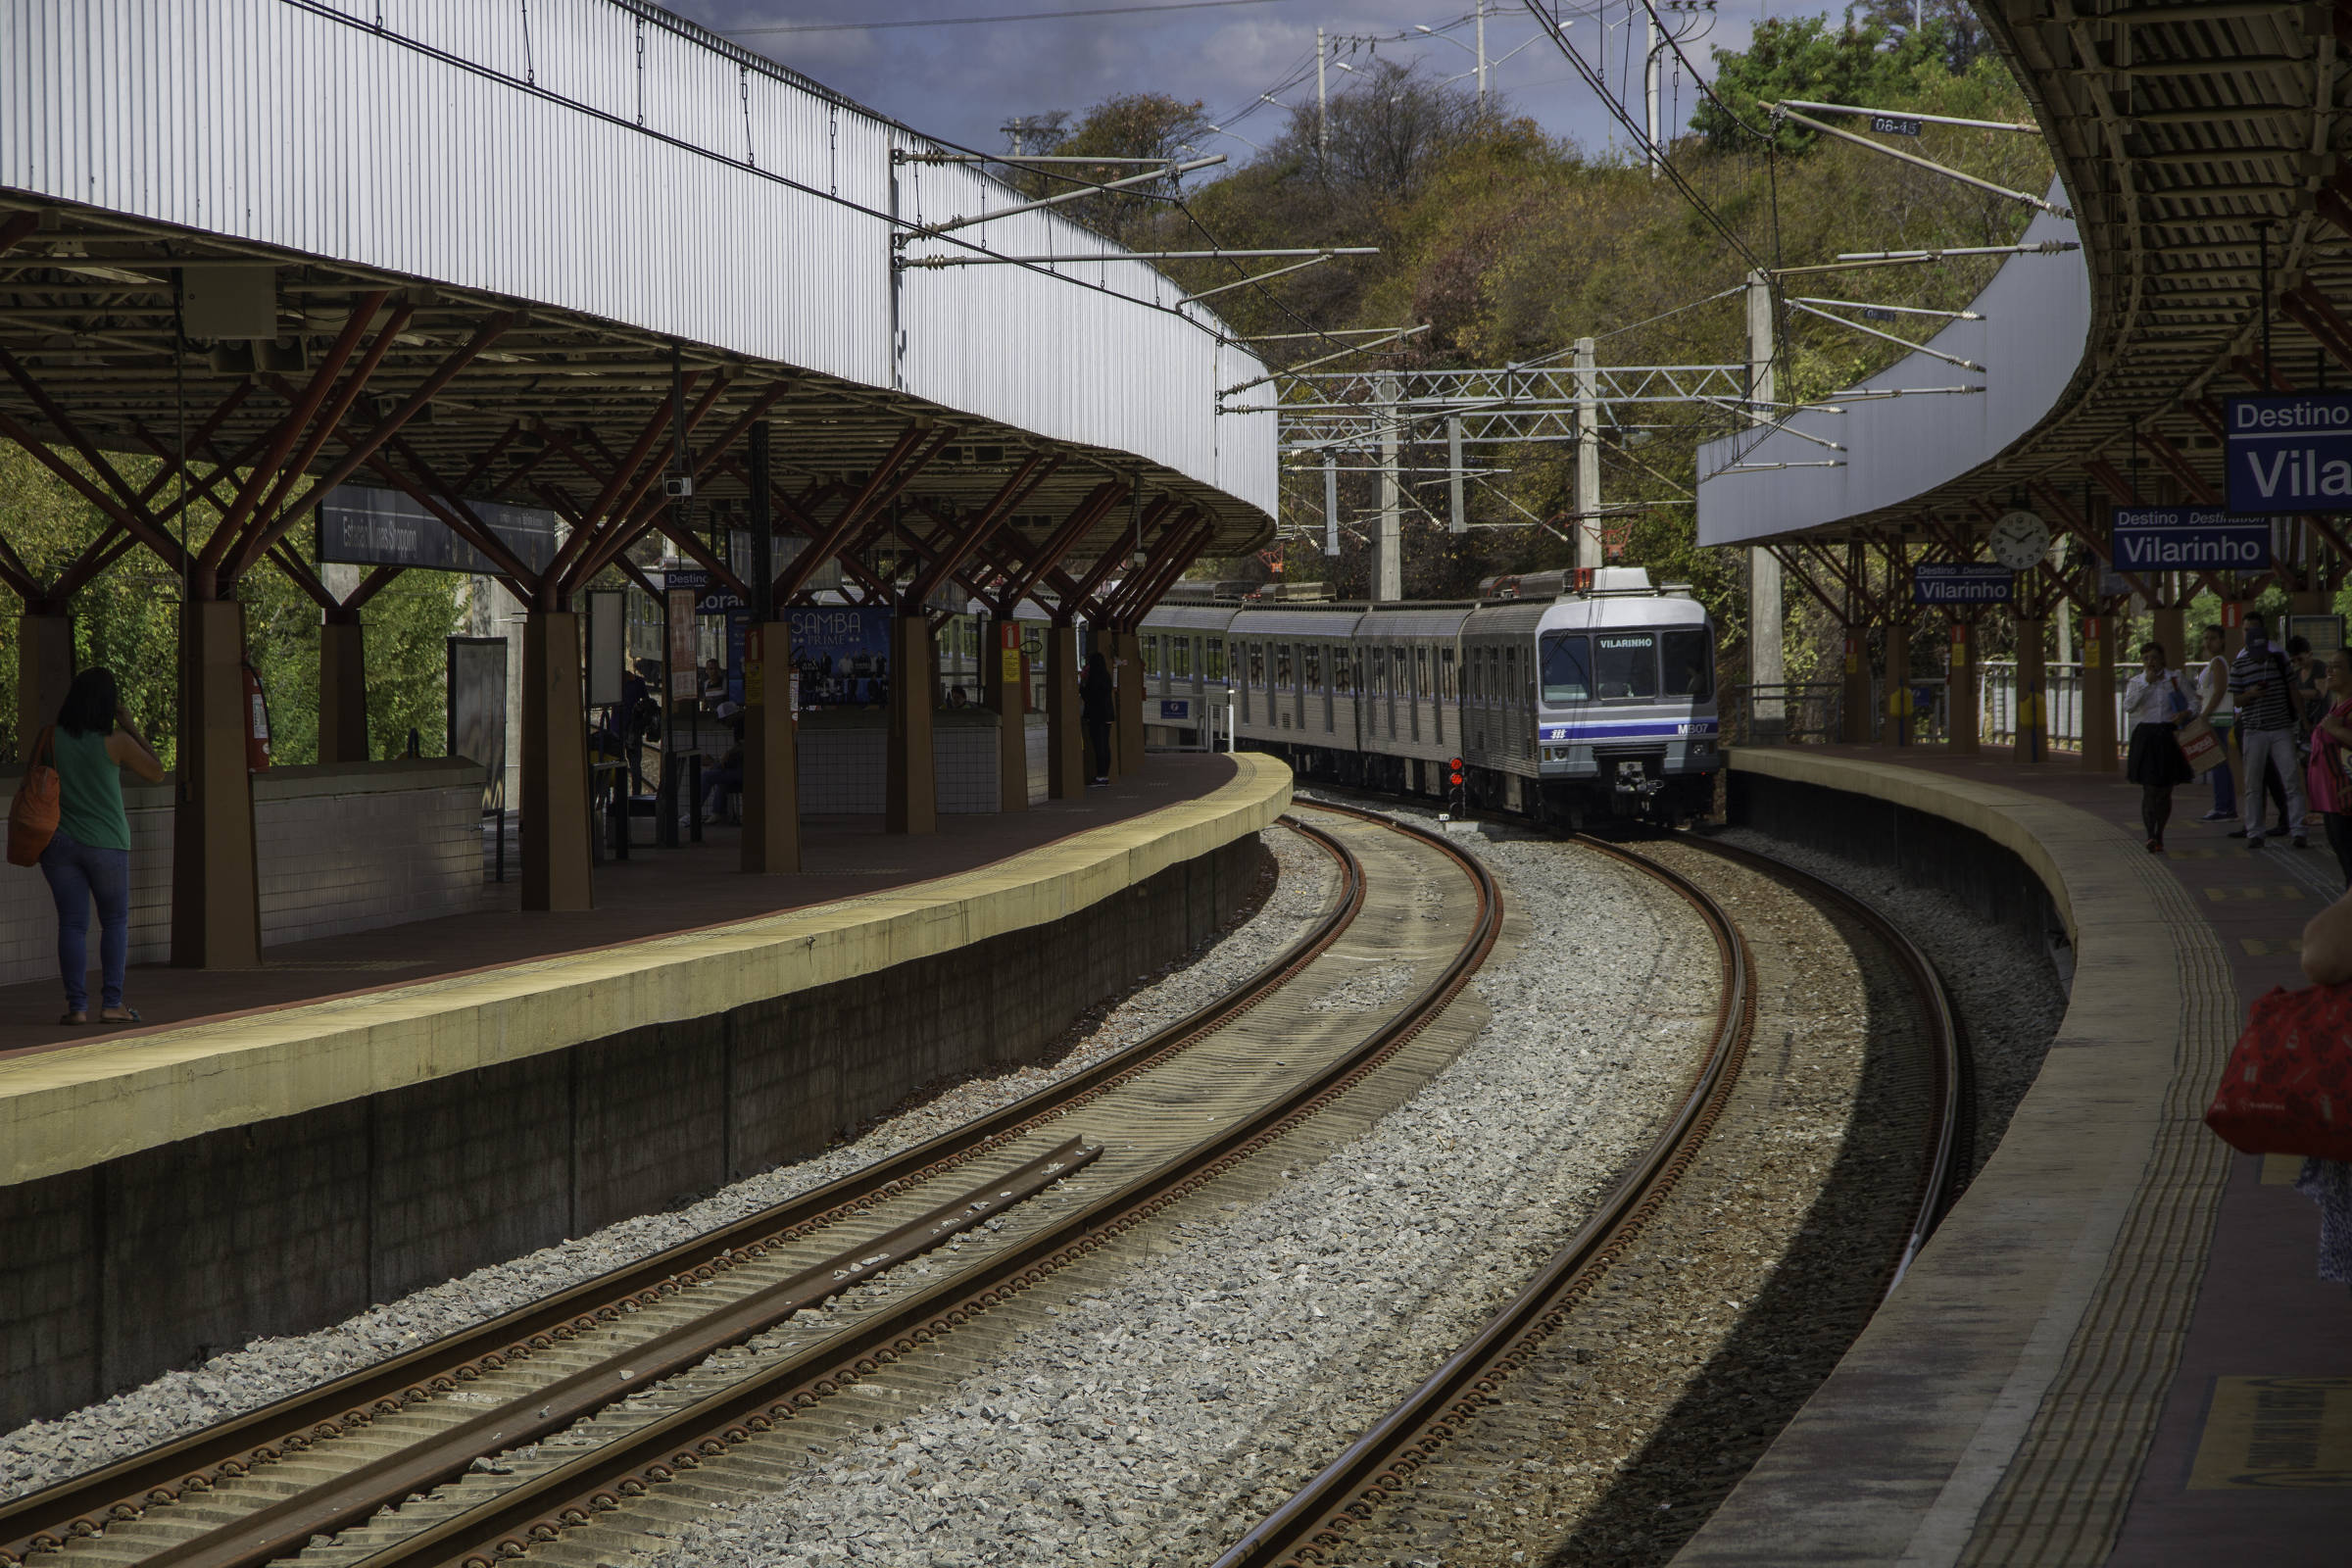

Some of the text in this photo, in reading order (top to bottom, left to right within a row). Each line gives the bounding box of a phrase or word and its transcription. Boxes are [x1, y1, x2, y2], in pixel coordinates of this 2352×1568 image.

[2235, 400, 2351, 428] Destino
[2246, 448, 2352, 498] Vila
[2118, 511, 2180, 526] Destino
[389, 519, 416, 561] Shopping
[2123, 535, 2261, 564] Vilarinho
[1917, 565, 1957, 575] Destino
[1921, 581, 2008, 600] Vilarinho
[791, 612, 860, 634] SAMBA
[808, 634, 846, 645] PRIME
[1599, 638, 1652, 649] VILARINHO
[1678, 723, 1709, 736] MB07
